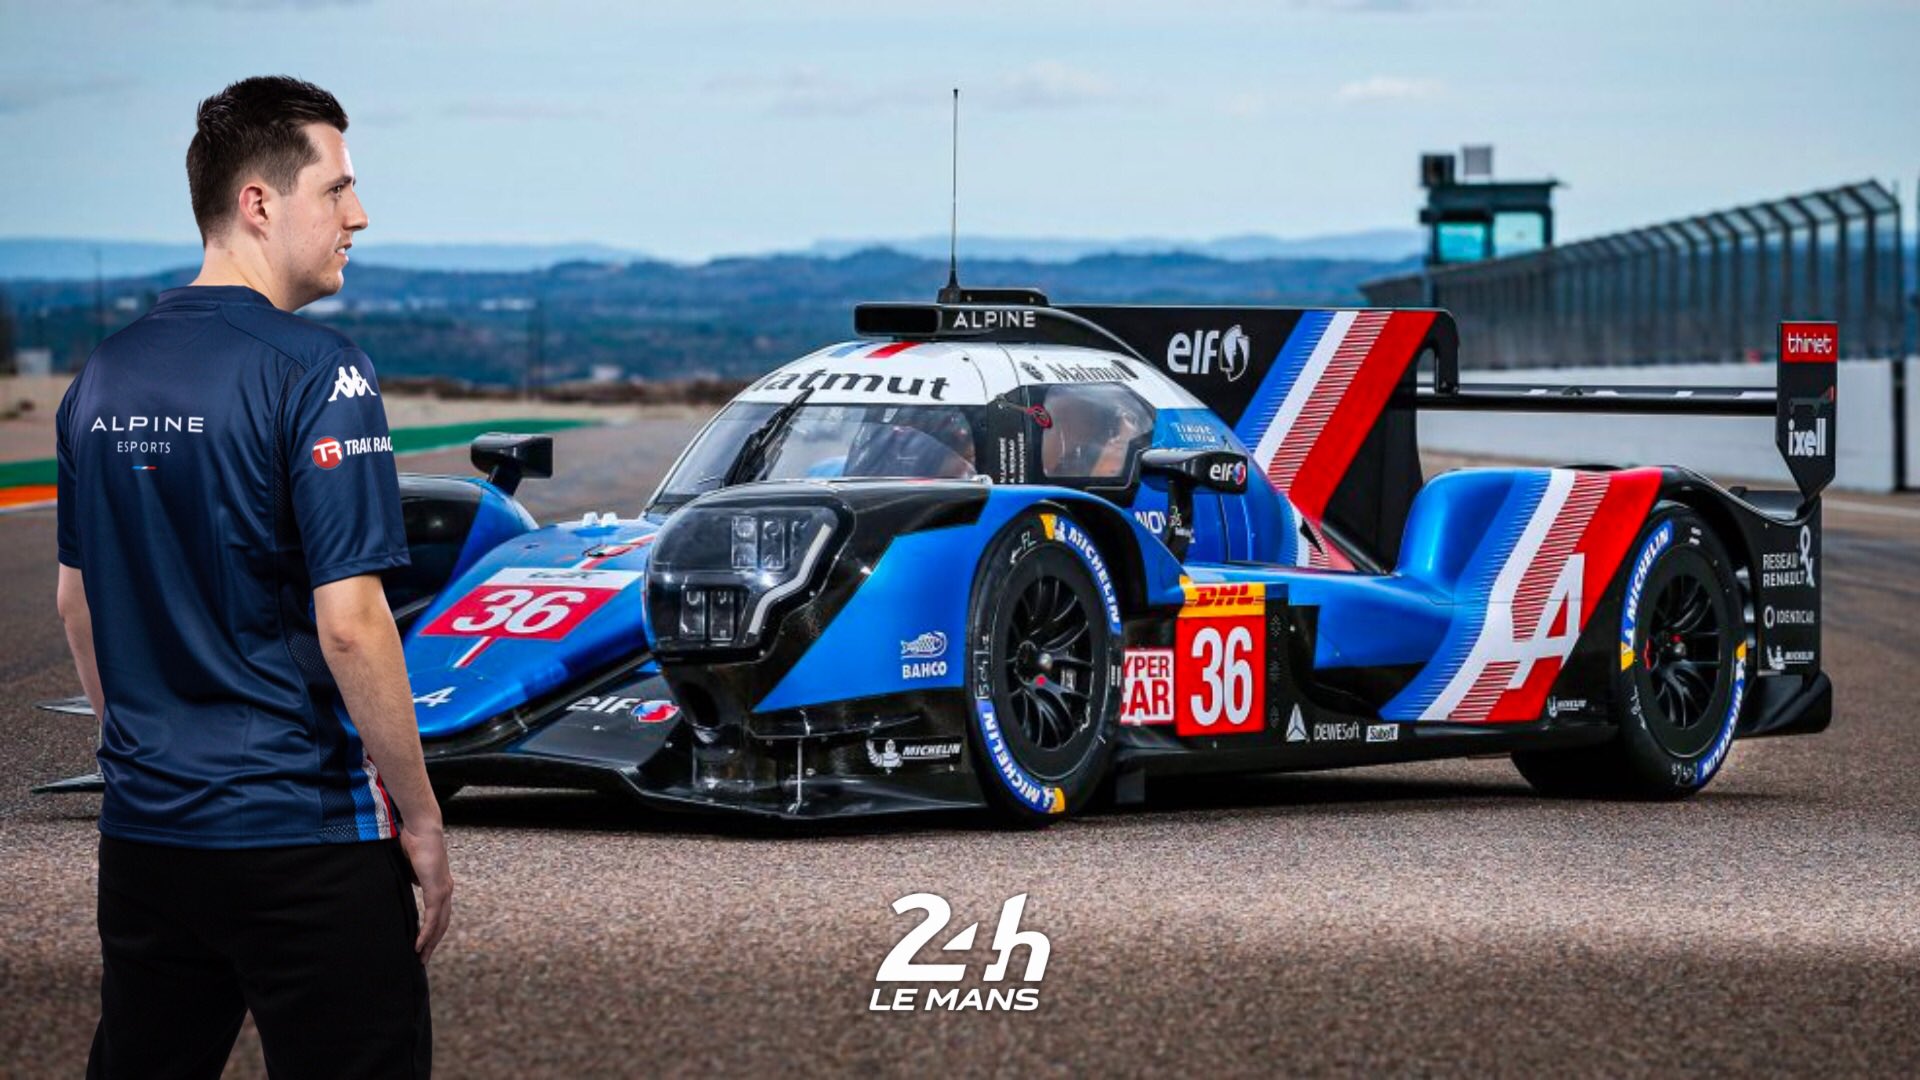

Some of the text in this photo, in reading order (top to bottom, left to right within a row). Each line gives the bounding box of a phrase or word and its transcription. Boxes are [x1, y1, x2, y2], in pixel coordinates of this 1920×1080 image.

[953, 310, 1037, 329] ALPINE
[1167, 330, 1220, 375] elf
[1787, 332, 1832, 354] thiriet
[752, 368, 950, 401] atmut
[91, 416, 204, 433] ALPINE
[117, 441, 171, 454] ESPORTS
[1788, 418, 1827, 458] ixell
[1209, 462, 1235, 482] elf
[1068, 527, 1120, 624] MICHELIN
[1627, 528, 1670, 618] MICHELIN
[1763, 570, 1805, 588] RENAULT
[1194, 584, 1255, 606] DHL
[452, 589, 587, 634] 36
[902, 662, 947, 679] BAHCO
[1190, 626, 1253, 726] 36
[566, 695, 642, 713] elf
[1121, 681, 1170, 716] AR
[1313, 721, 1360, 740] DEWESoft
[903, 743, 961, 757] MICHELIN
[982, 712, 1042, 804] MICHELIN
